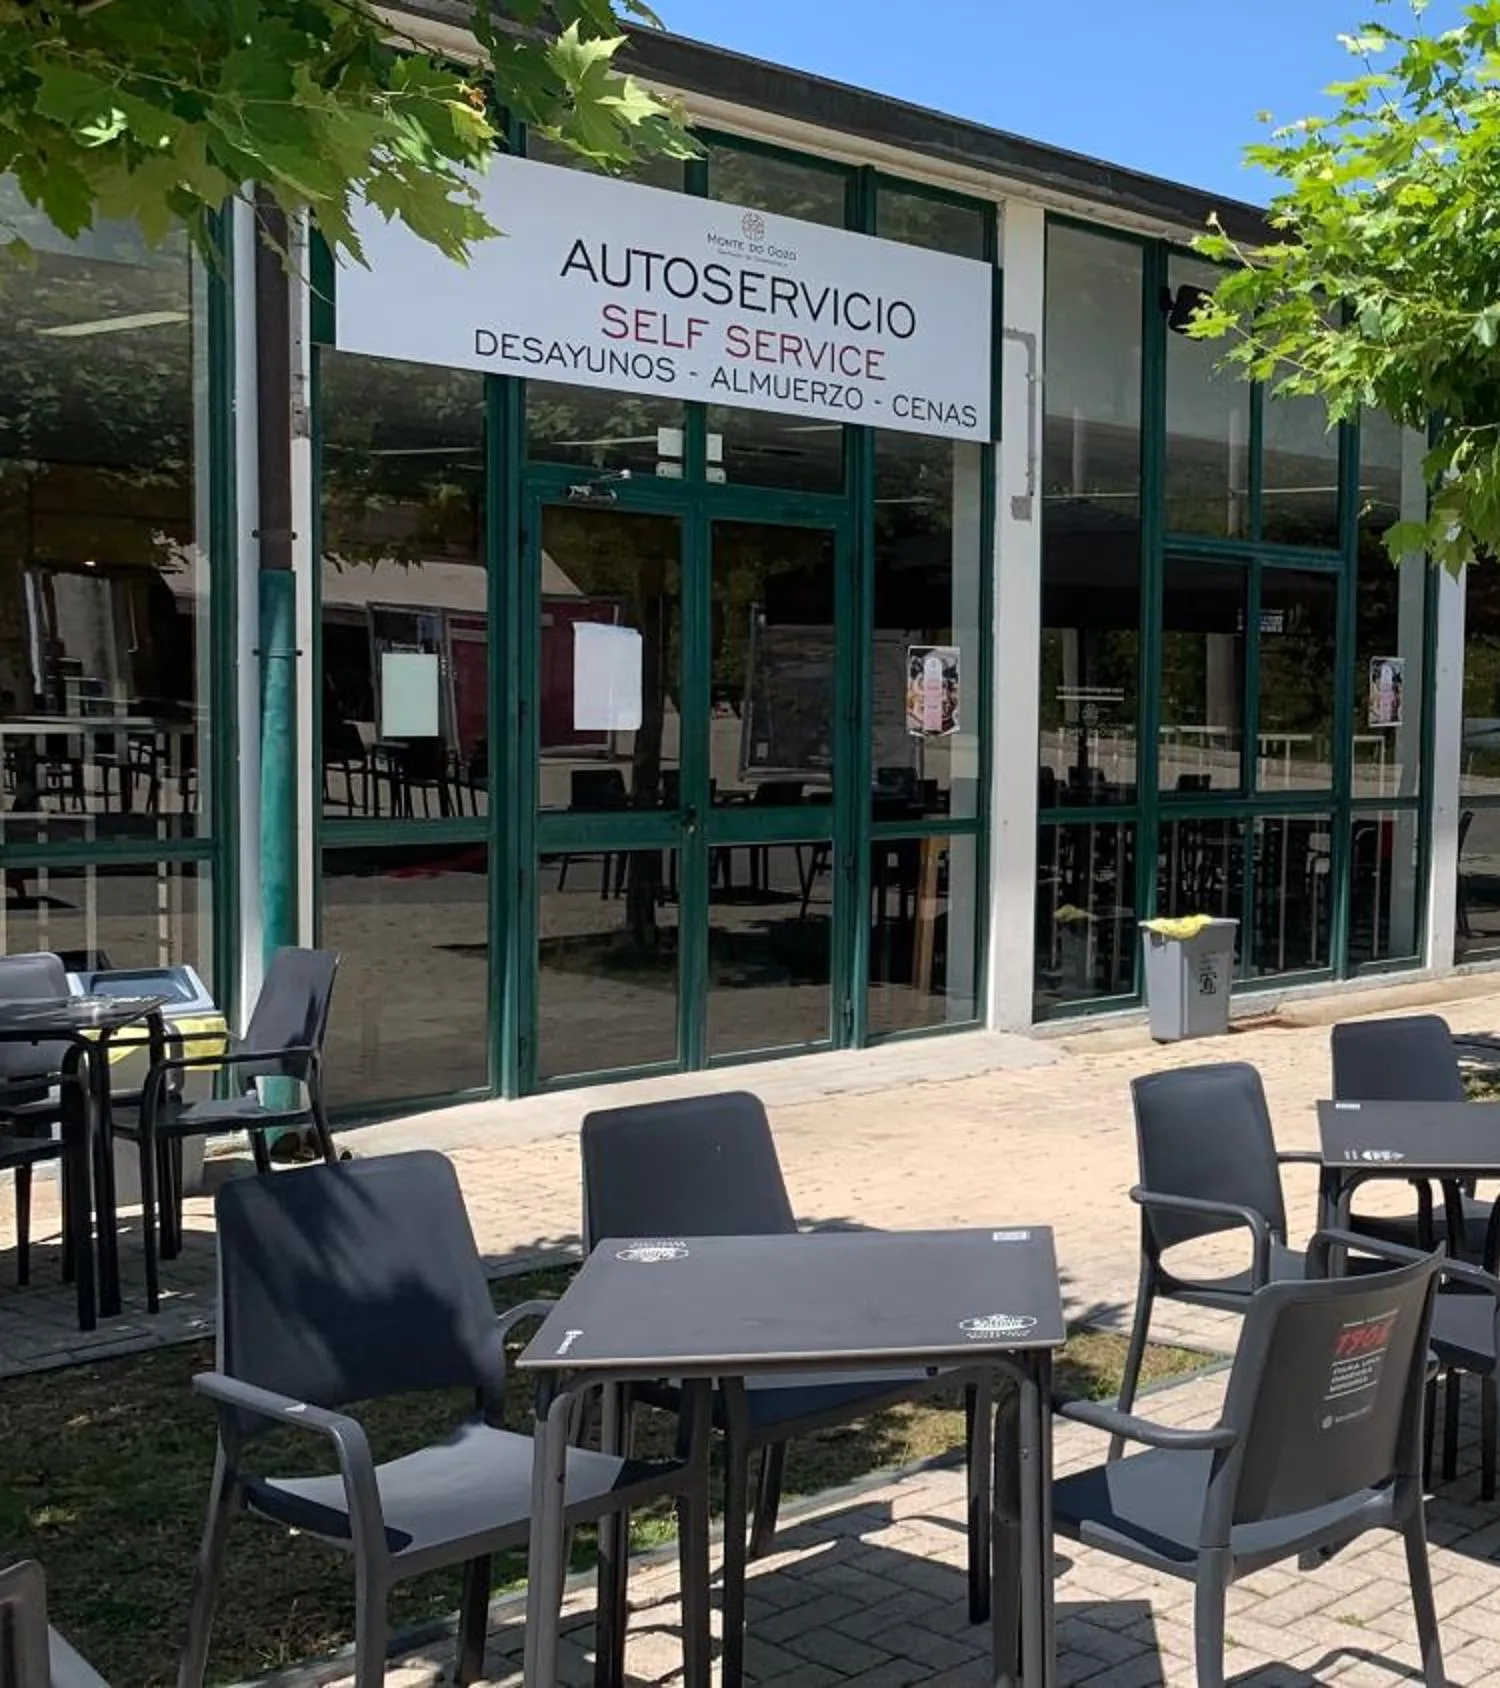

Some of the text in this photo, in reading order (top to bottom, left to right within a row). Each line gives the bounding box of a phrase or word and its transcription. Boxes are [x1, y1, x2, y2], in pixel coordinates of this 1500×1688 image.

[559, 238, 917, 340] AUTOSERVICIO
[475, 328, 676, 384] DESAYUNOS
[710, 369, 864, 412] ALMUERZO
[892, 394, 978, 429] CENAS
[600, 304, 887, 381] SELF SERVICE
